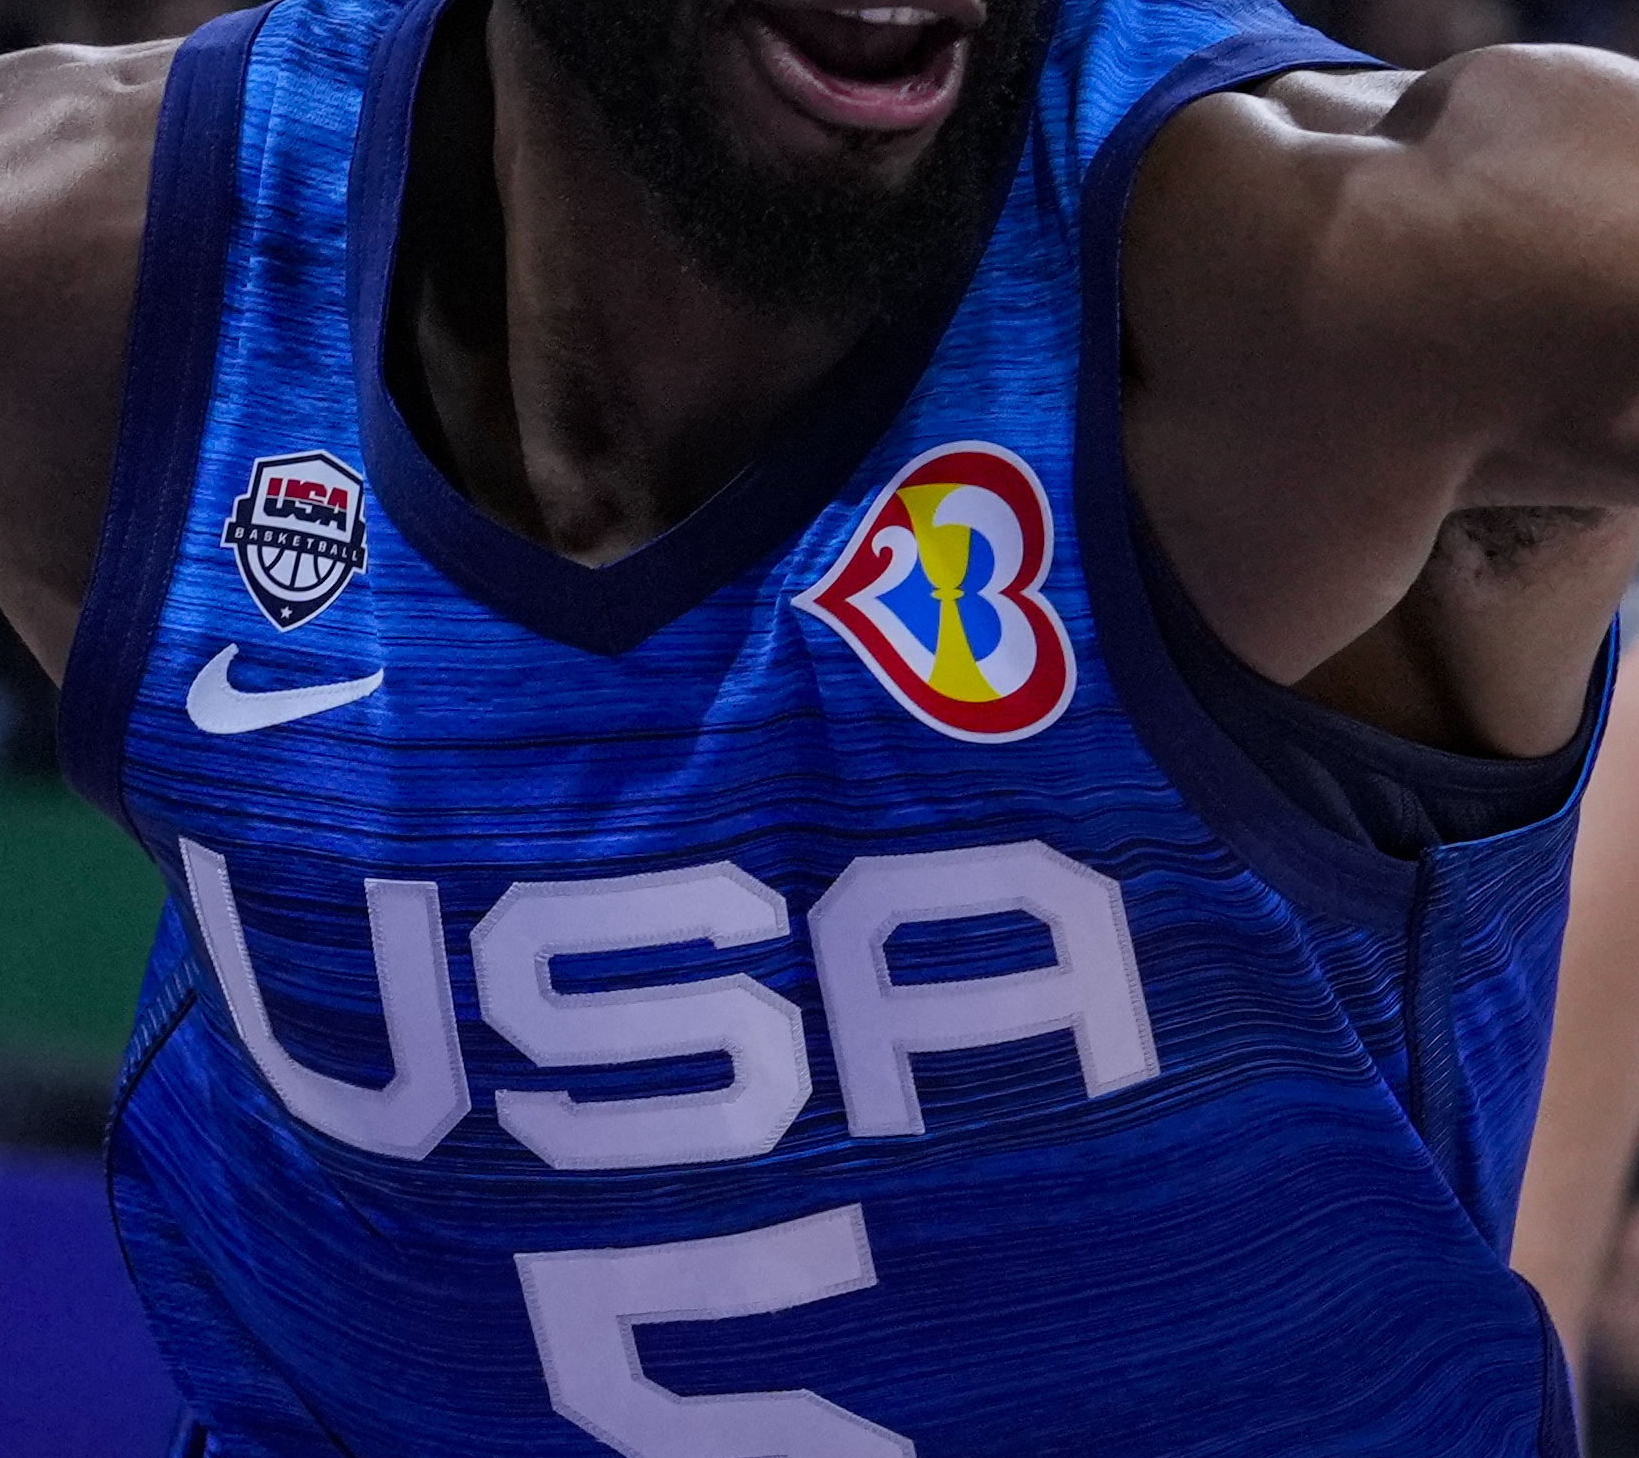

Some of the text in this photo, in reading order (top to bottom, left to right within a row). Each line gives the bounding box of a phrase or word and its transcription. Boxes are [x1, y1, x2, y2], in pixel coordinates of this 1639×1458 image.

[263, 477, 349, 533] USA
[234, 525, 359, 562] BASKETBALL
[179, 836, 1160, 1171] USA
